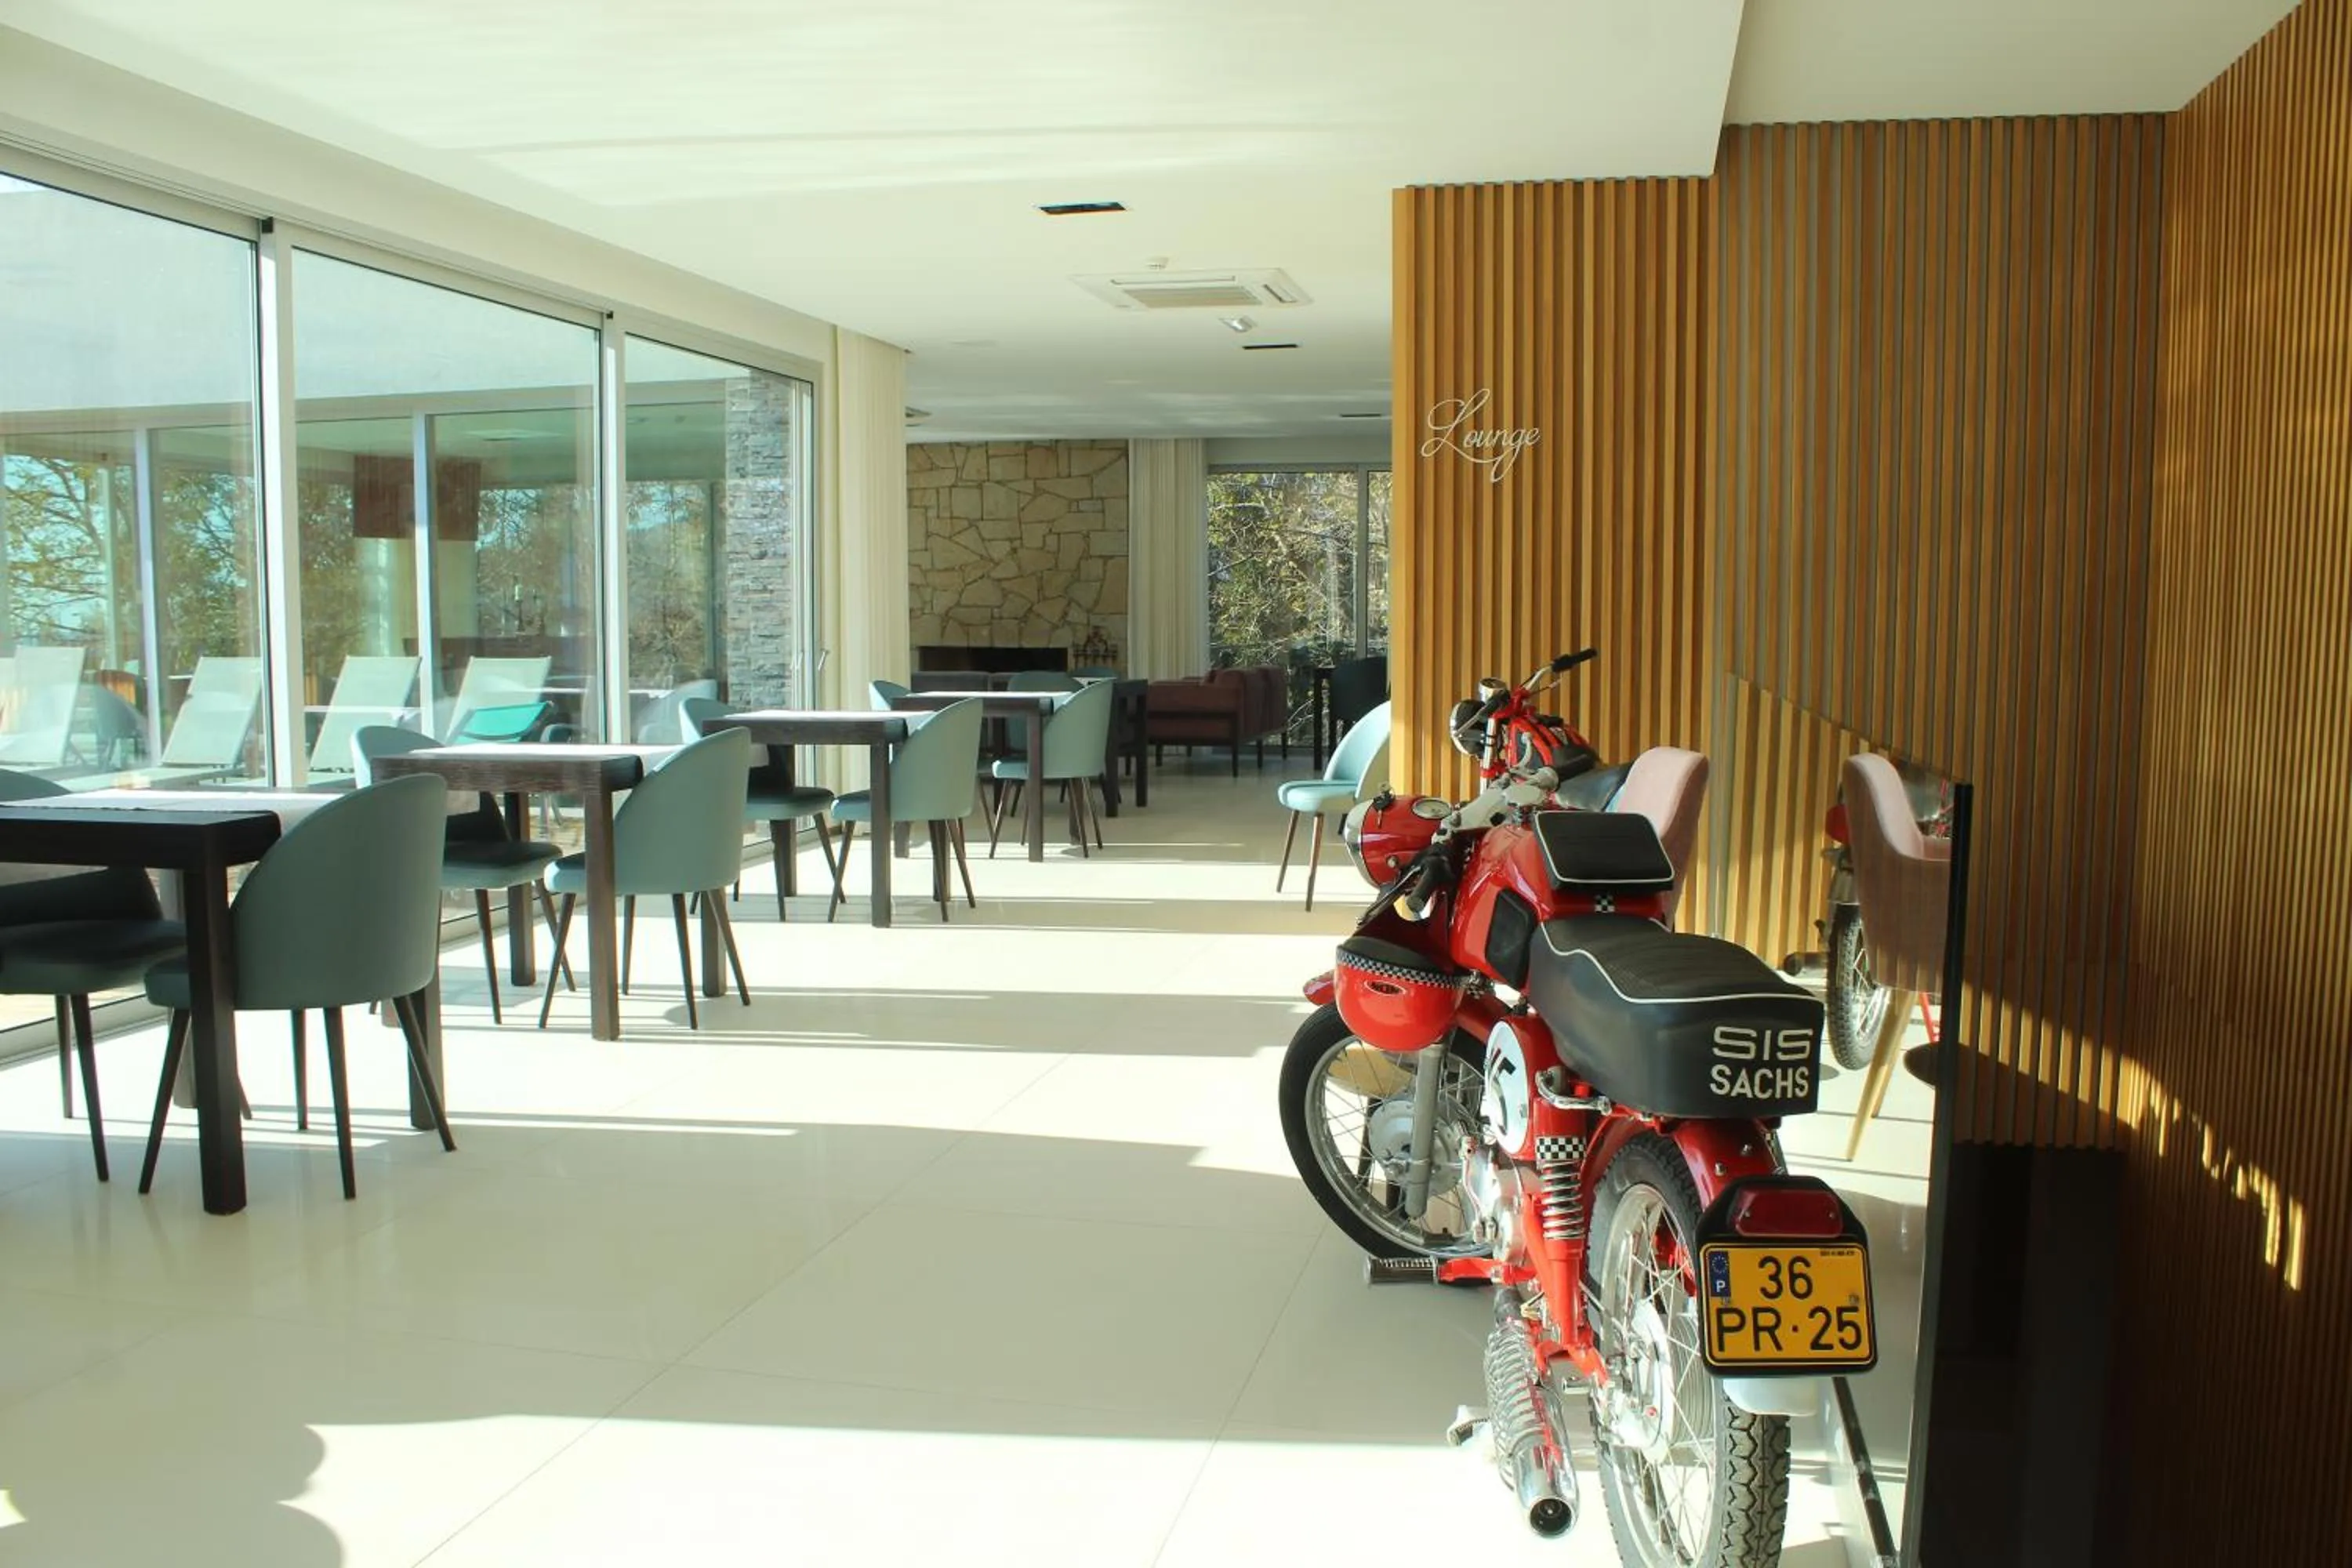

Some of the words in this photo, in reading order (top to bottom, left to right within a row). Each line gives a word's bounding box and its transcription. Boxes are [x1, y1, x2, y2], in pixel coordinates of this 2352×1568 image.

[1421, 388, 1541, 483] Lounge
[1712, 1026, 1813, 1061] SIS
[1709, 1064, 1809, 1098] SACHS
[1716, 1279, 1726, 1293] P
[1758, 1256, 1813, 1300] 36
